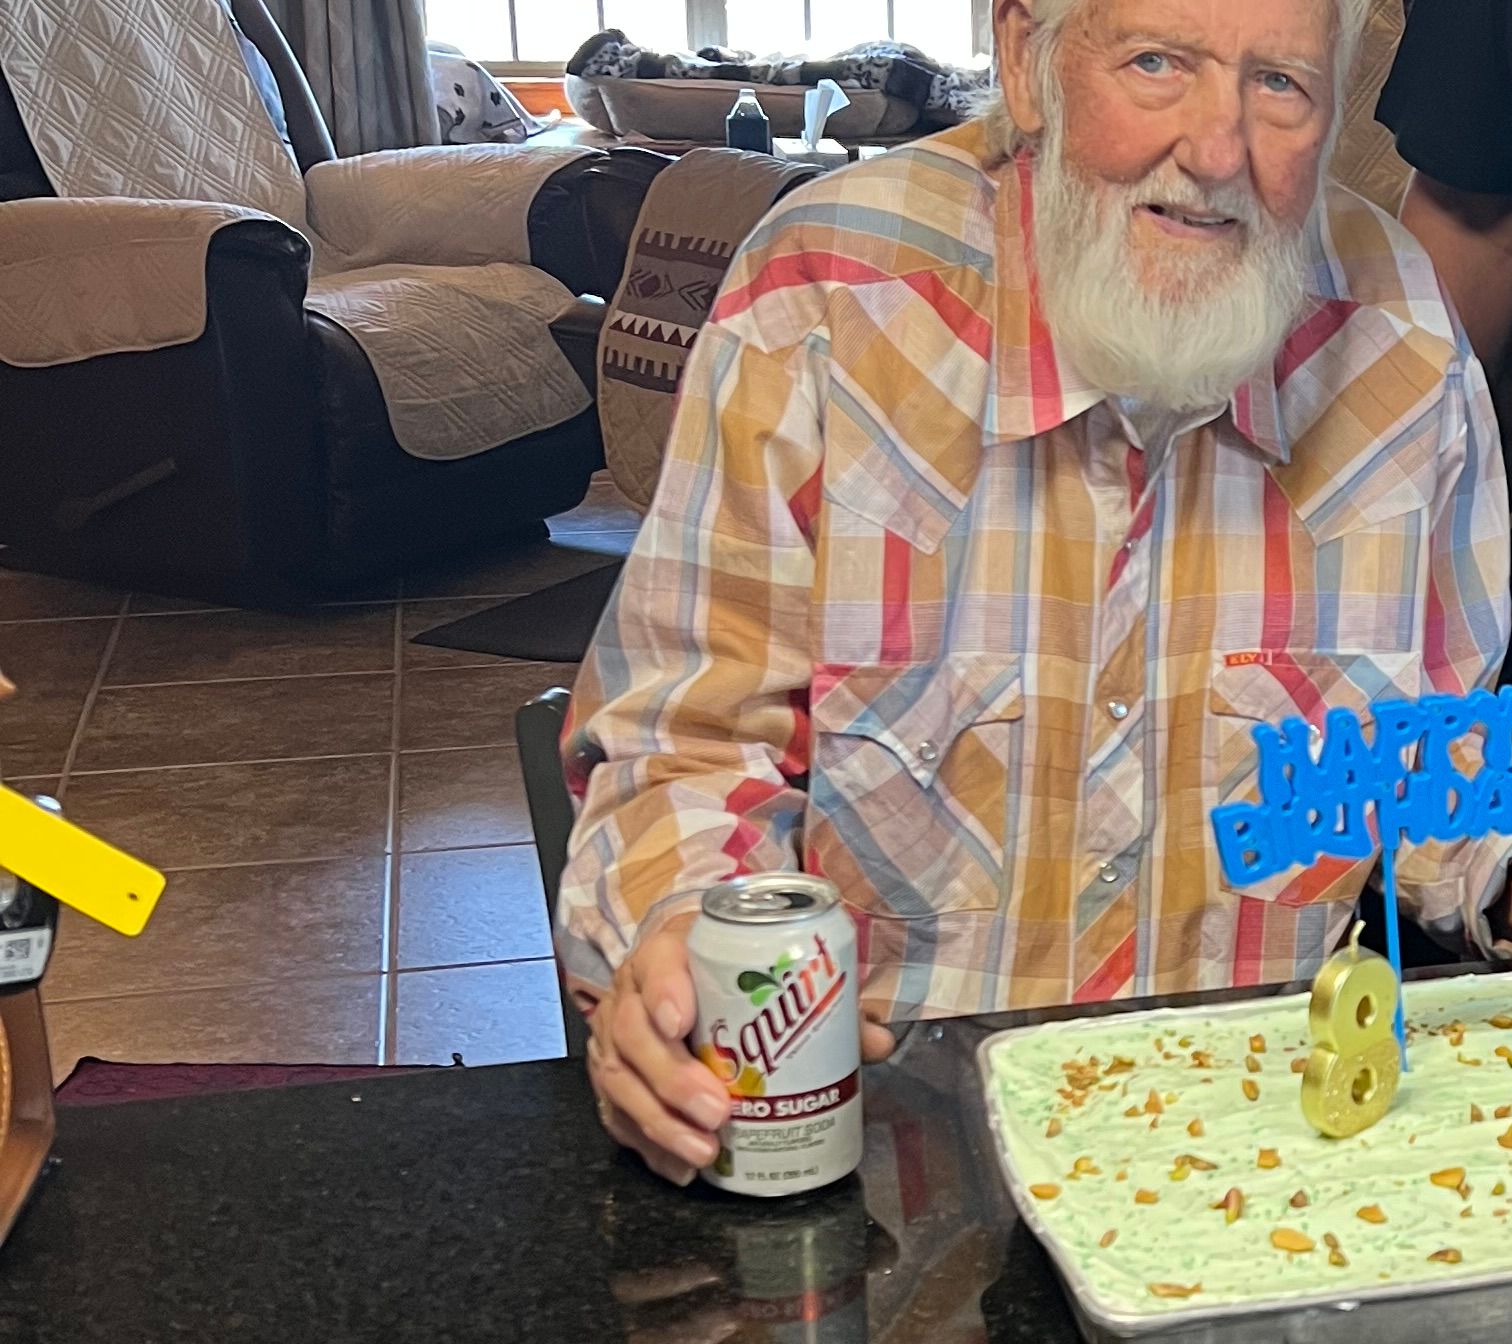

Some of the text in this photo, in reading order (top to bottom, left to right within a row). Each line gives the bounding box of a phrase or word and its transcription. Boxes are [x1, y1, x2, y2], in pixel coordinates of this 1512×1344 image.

[711, 932, 838, 1085] Squirt
[731, 1088, 840, 1118] ERO SUGAR
